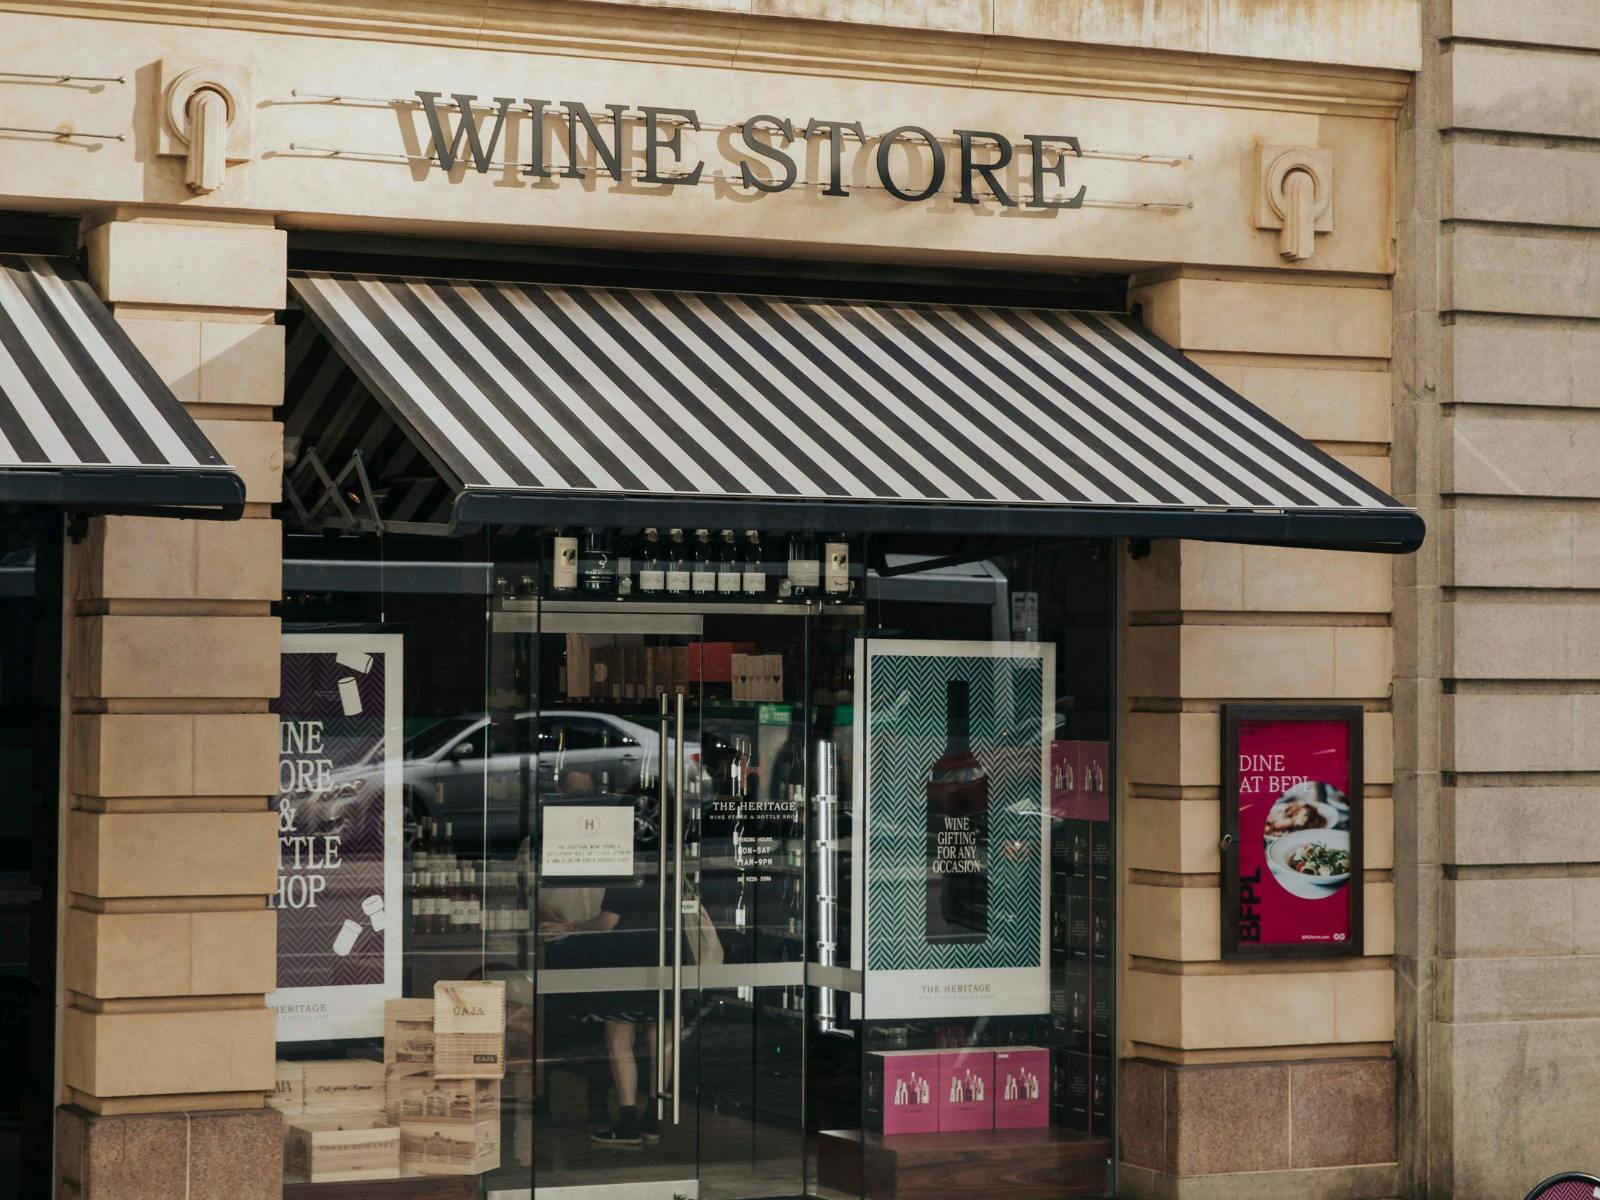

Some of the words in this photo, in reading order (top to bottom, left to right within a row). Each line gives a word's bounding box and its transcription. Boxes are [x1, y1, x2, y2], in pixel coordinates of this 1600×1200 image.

[415, 90, 705, 186] WINE
[740, 114, 1087, 209] STORE
[1239, 754, 1285, 772] DINE
[1239, 776, 1263, 793] AT
[713, 802, 736, 811] THE
[740, 802, 797, 811] HERITAGE
[279, 798, 297, 832] &
[584, 819, 594, 831] H
[944, 817, 970, 831] WINE
[937, 832, 976, 845] GIFTING
[738, 846, 771, 855] ON-SAT
[937, 846, 956, 859] FOR
[958, 846, 977, 859] ANY
[933, 860, 981, 874] OCCASION
[921, 985, 940, 993] THE
[944, 984, 992, 993] HERITAGE
